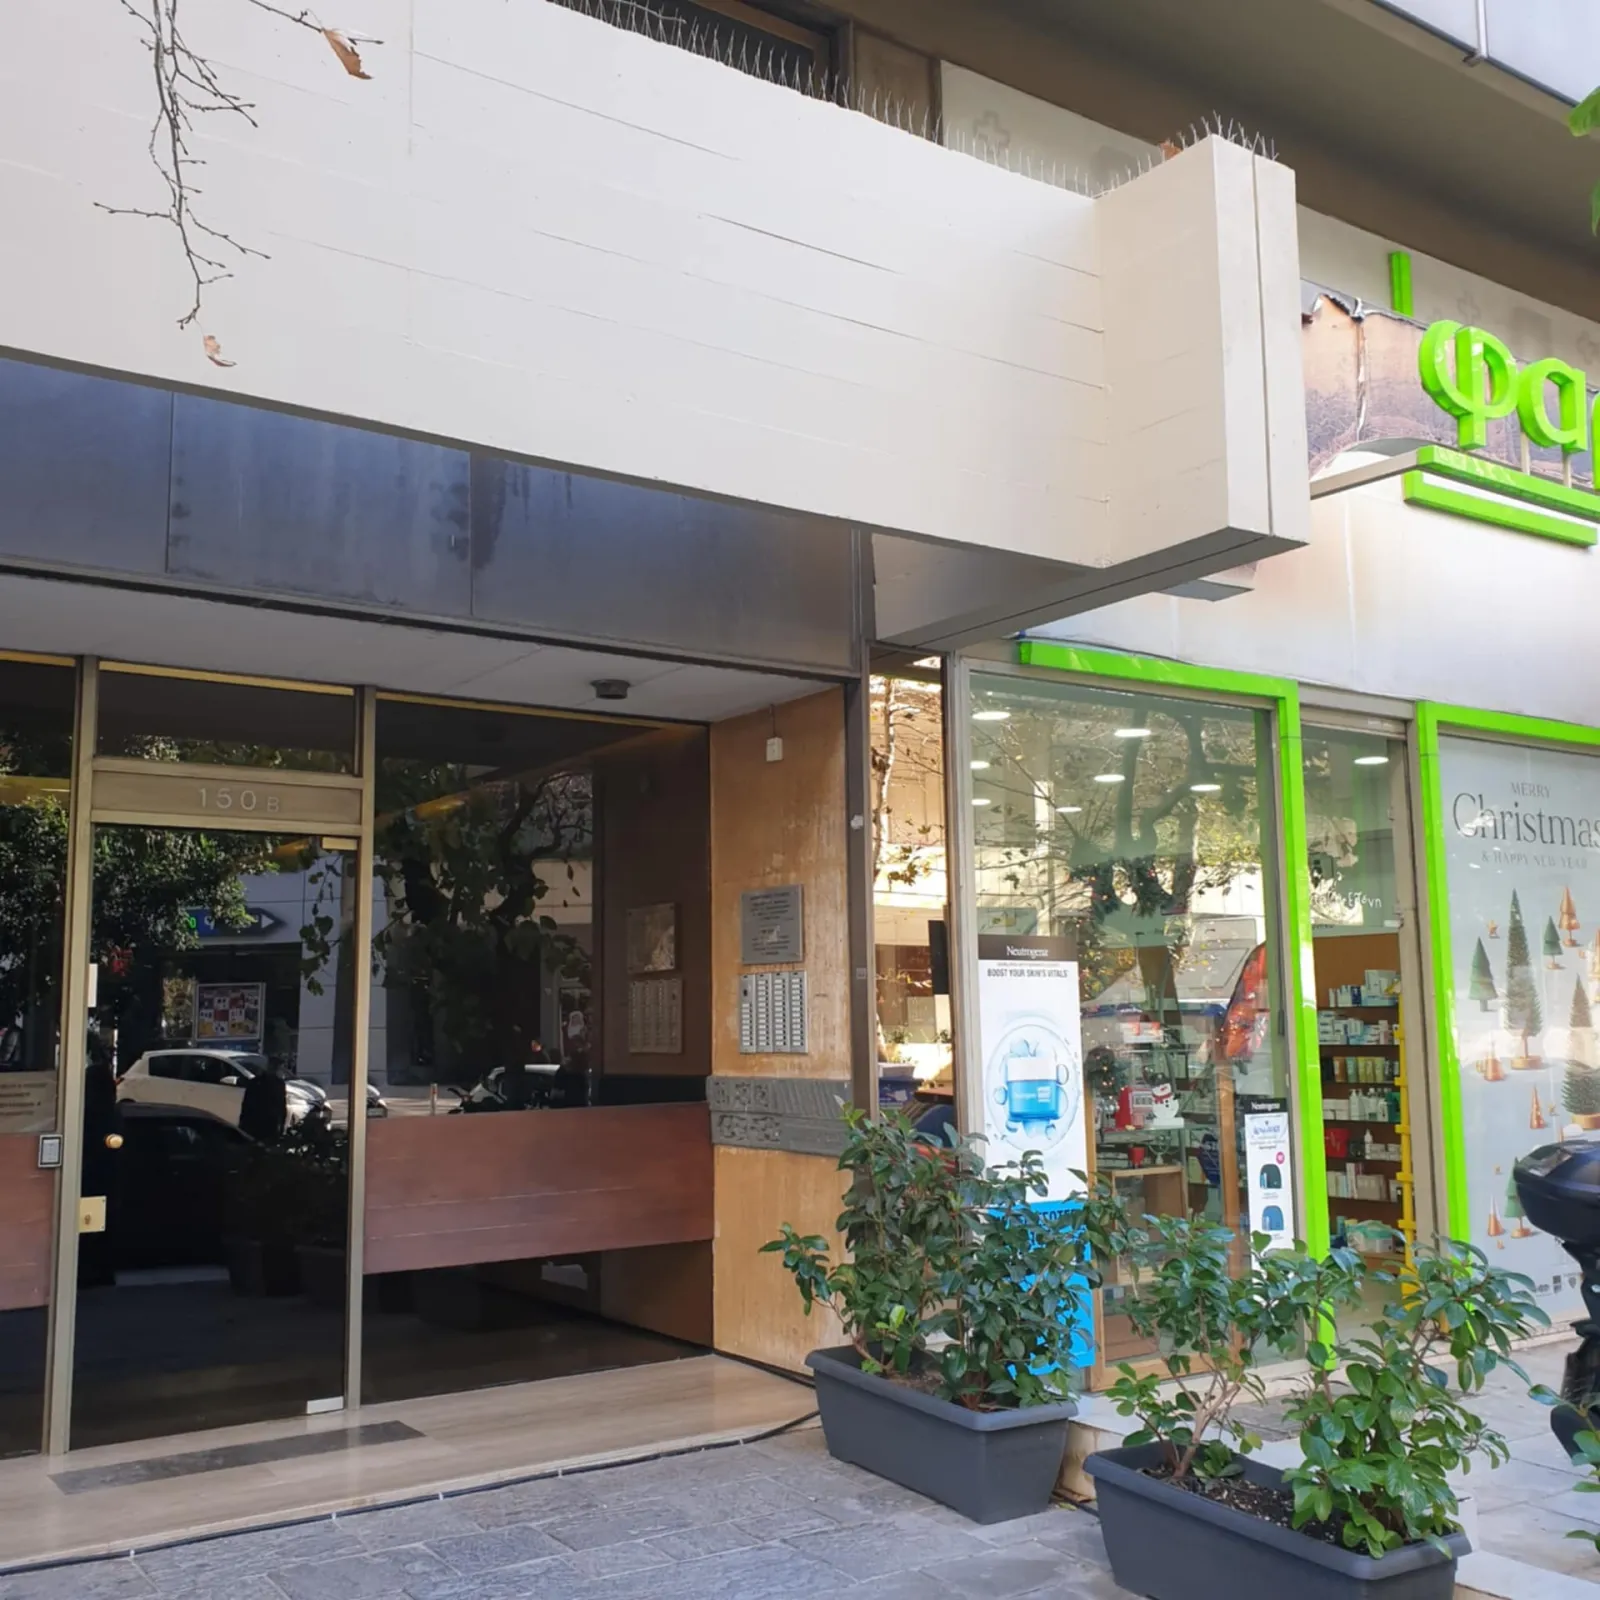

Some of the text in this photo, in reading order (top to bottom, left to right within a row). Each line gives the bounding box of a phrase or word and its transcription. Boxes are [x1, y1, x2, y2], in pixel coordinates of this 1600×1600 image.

[1419, 320, 1600, 491] φα
[1510, 782, 1550, 798] MERRY
[1493, 851, 1529, 865] HAPPY
[1533, 855, 1556, 867] NEW
[1560, 856, 1588, 869] YEAR
[1006, 945, 1049, 959] Neutrogena
[987, 968, 1007, 977] BOOST
[1009, 969, 1025, 977] YOUR
[1047, 969, 1068, 978] VITALS
